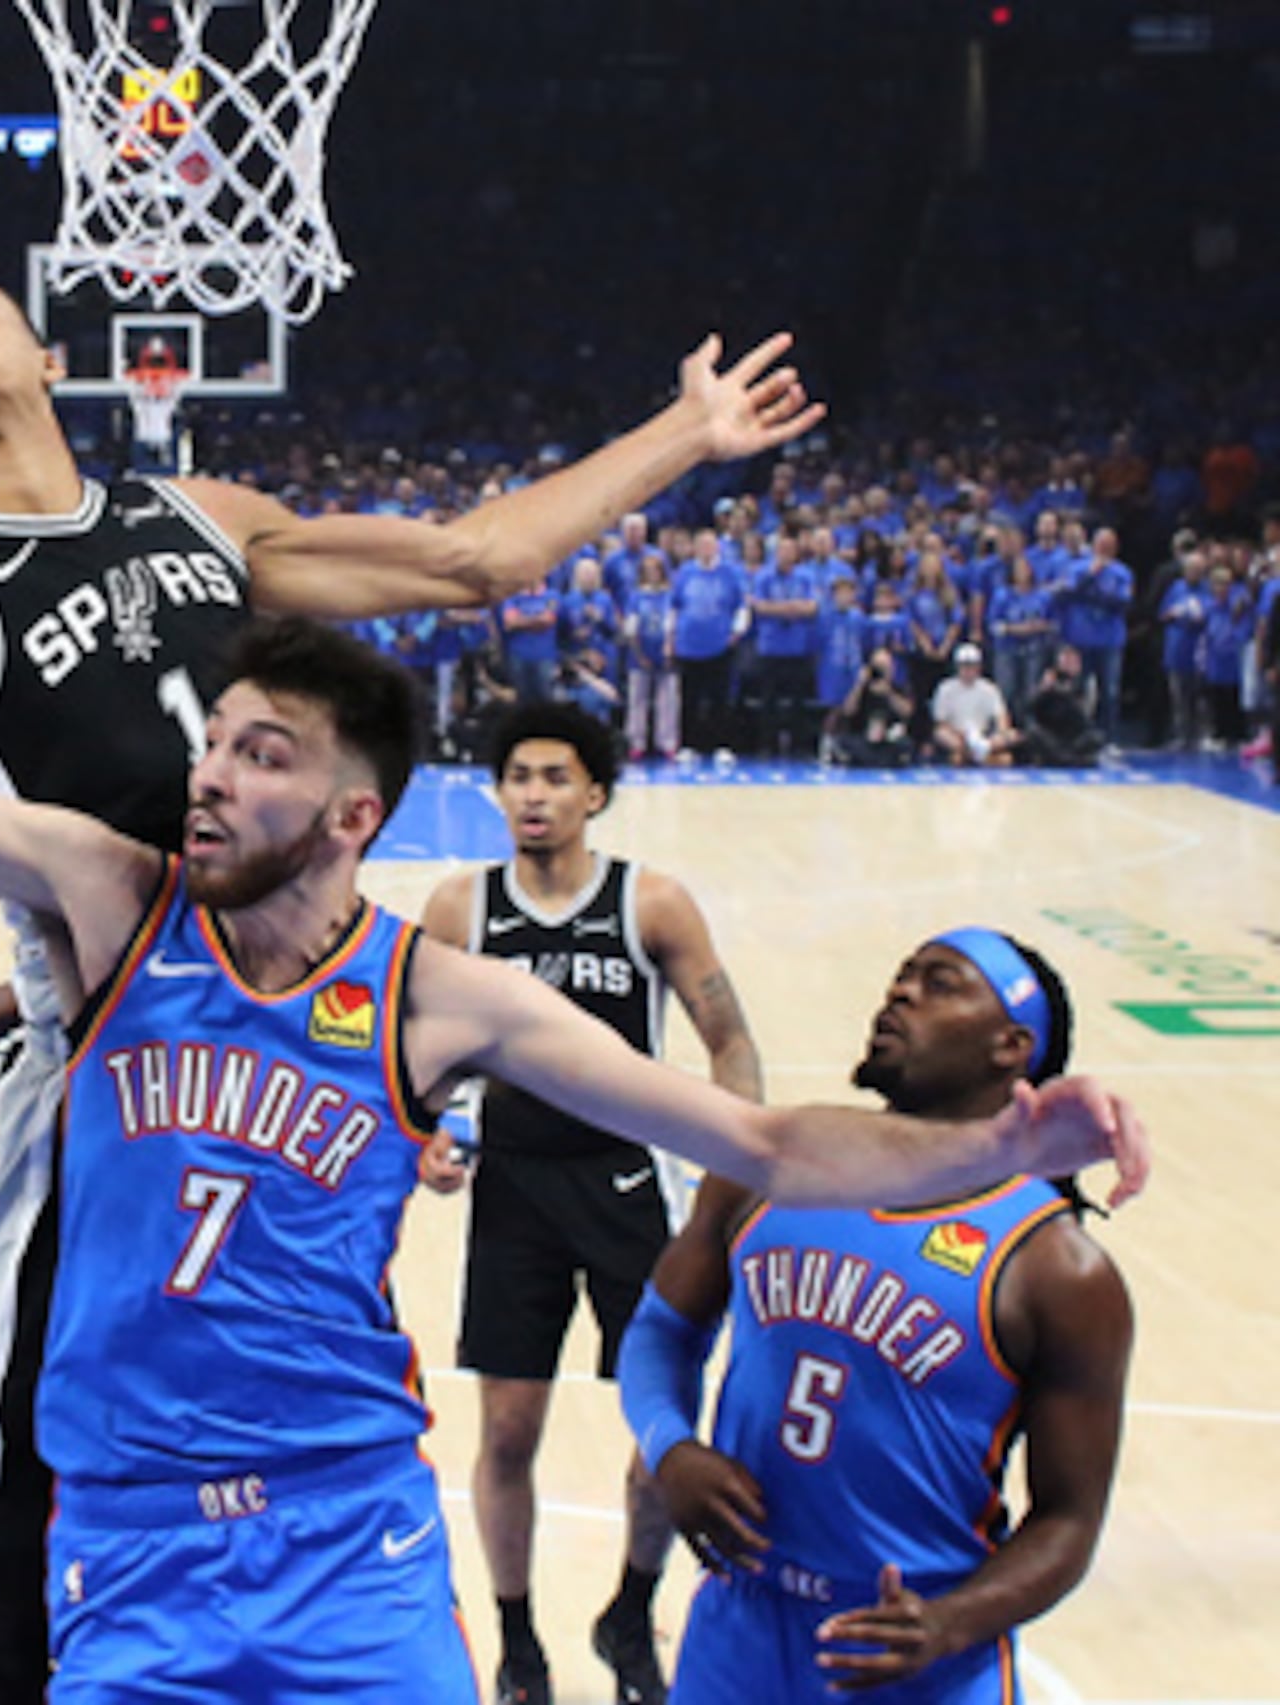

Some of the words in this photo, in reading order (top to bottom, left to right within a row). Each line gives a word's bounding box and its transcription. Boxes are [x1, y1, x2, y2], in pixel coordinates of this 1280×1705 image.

[22, 552, 241, 688] SPURS
[157, 667, 208, 768] 1
[105, 1041, 381, 1193] THUNDER
[163, 1165, 253, 1296] 7
[742, 1246, 968, 1388] THUNDER
[779, 1351, 851, 1465] 5
[196, 1473, 269, 1521] OKC
